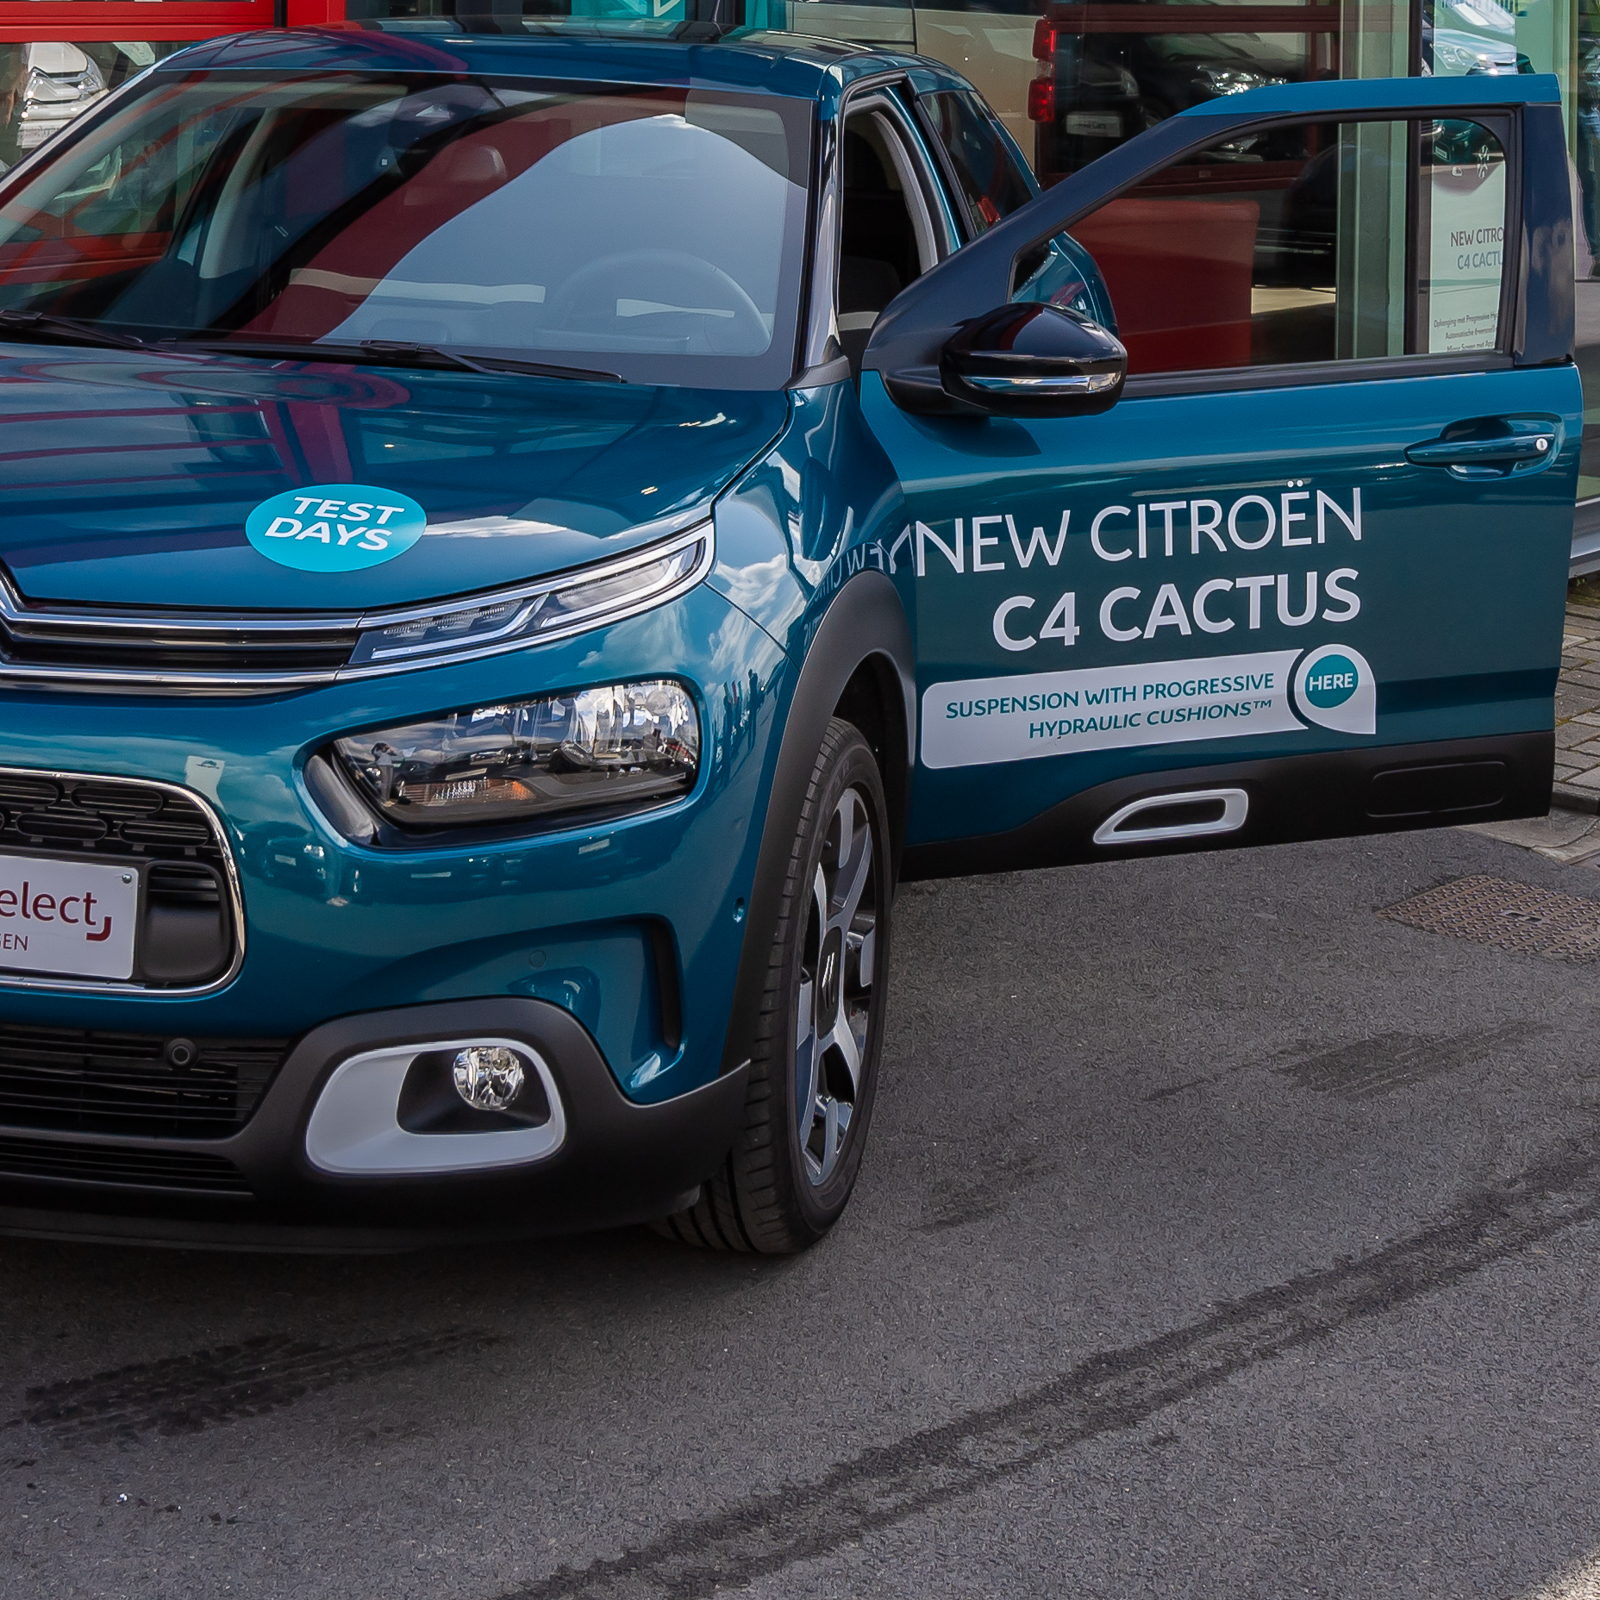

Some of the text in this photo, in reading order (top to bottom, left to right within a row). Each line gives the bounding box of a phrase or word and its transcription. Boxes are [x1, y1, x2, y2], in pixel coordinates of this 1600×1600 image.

[1451, 226, 1504, 247] NEW CITRO
[1457, 250, 1502, 270] C4 CACTU
[294, 496, 405, 525] TEST
[264, 517, 393, 551] DAYS
[914, 479, 1363, 577] NEW CITROËN
[992, 567, 1361, 652] C4 CACTUS
[945, 672, 1275, 720] SUSPENSION WITH PROGRESSIVE
[1308, 673, 1355, 694] HERE
[1028, 711, 1141, 740] HYDRAULIC
